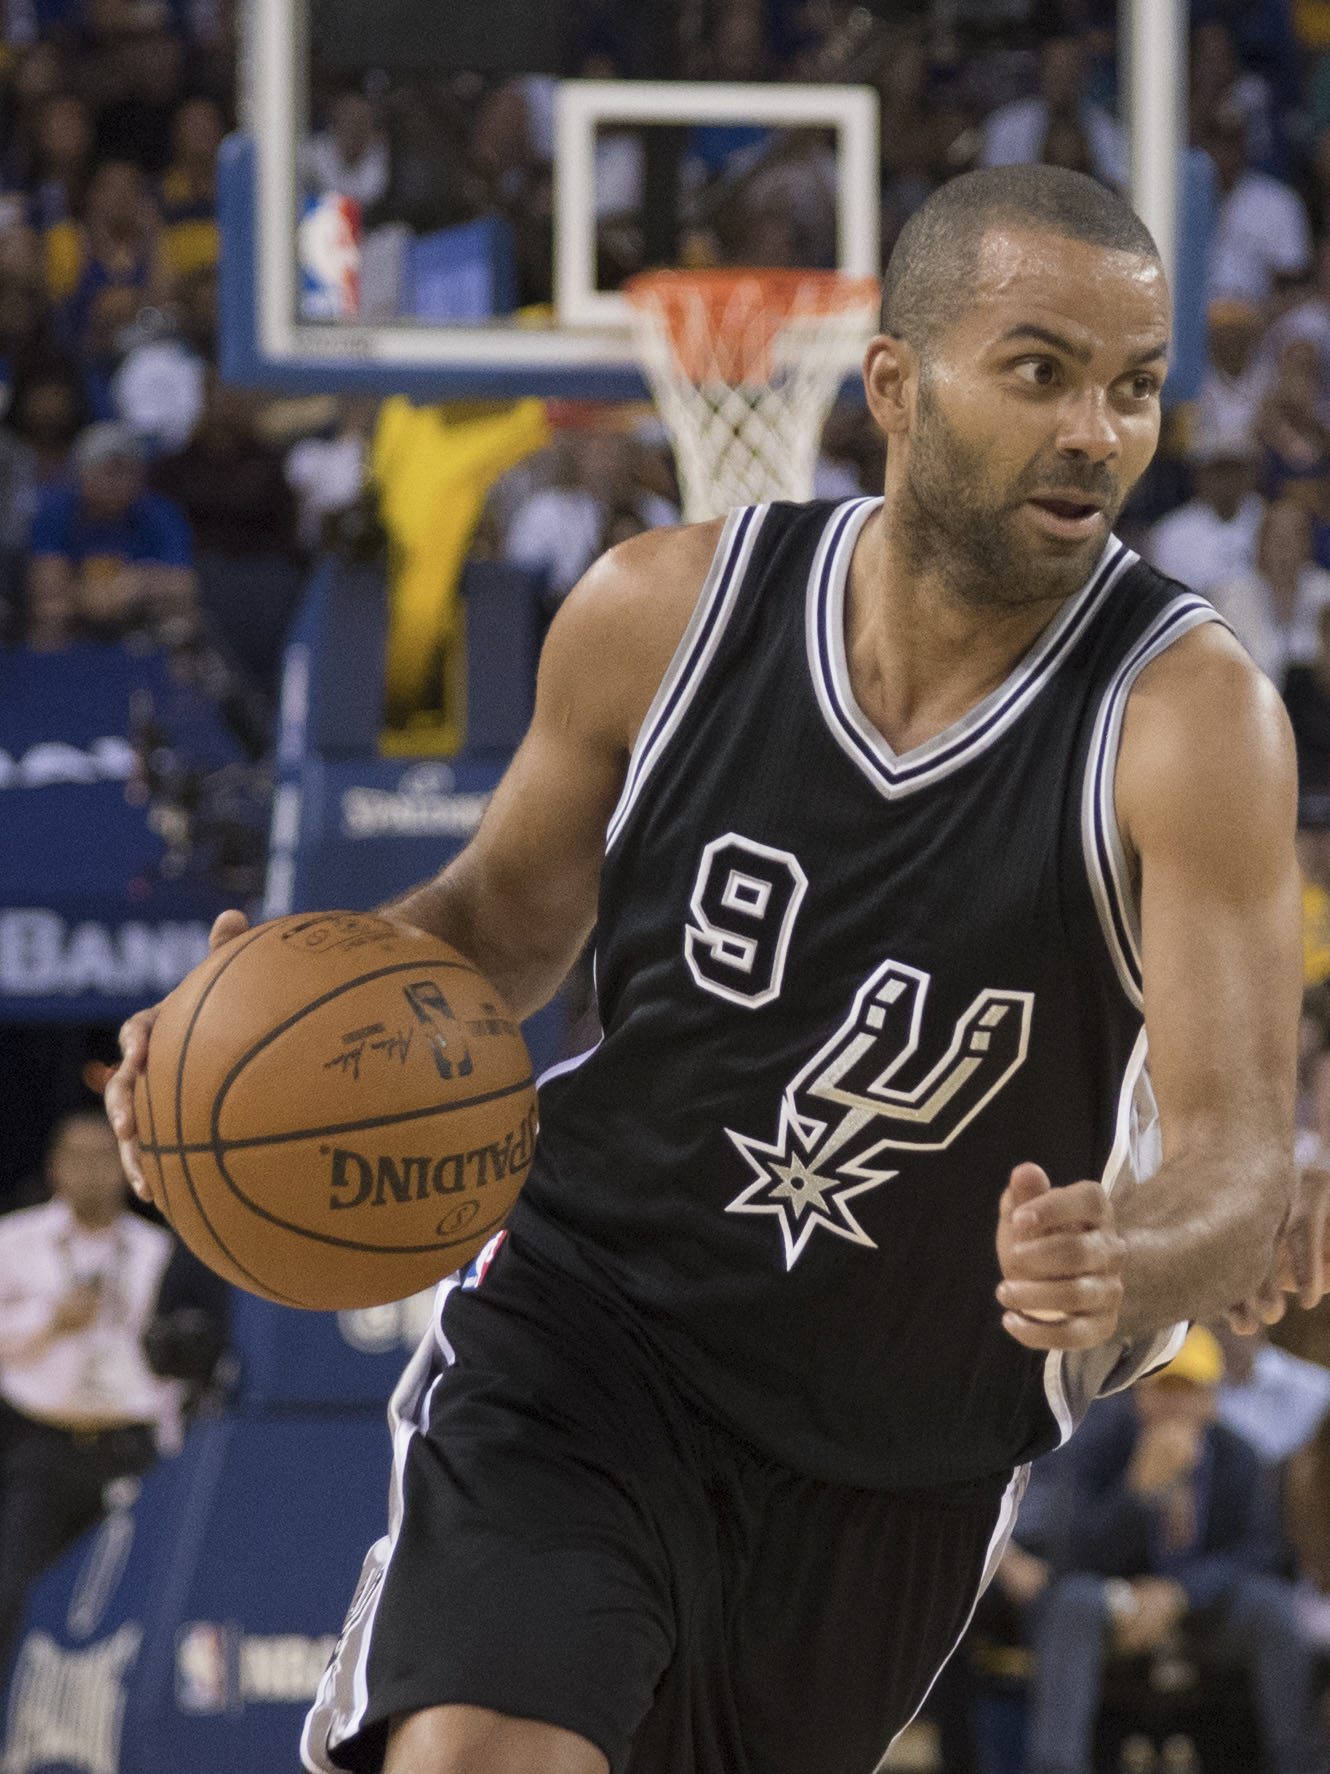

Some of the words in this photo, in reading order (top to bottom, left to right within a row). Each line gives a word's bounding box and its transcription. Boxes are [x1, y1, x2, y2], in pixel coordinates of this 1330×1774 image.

[0, 906, 210, 995] BAN
[684, 831, 809, 1009] 9
[329, 1102, 537, 1211] SPALDING
